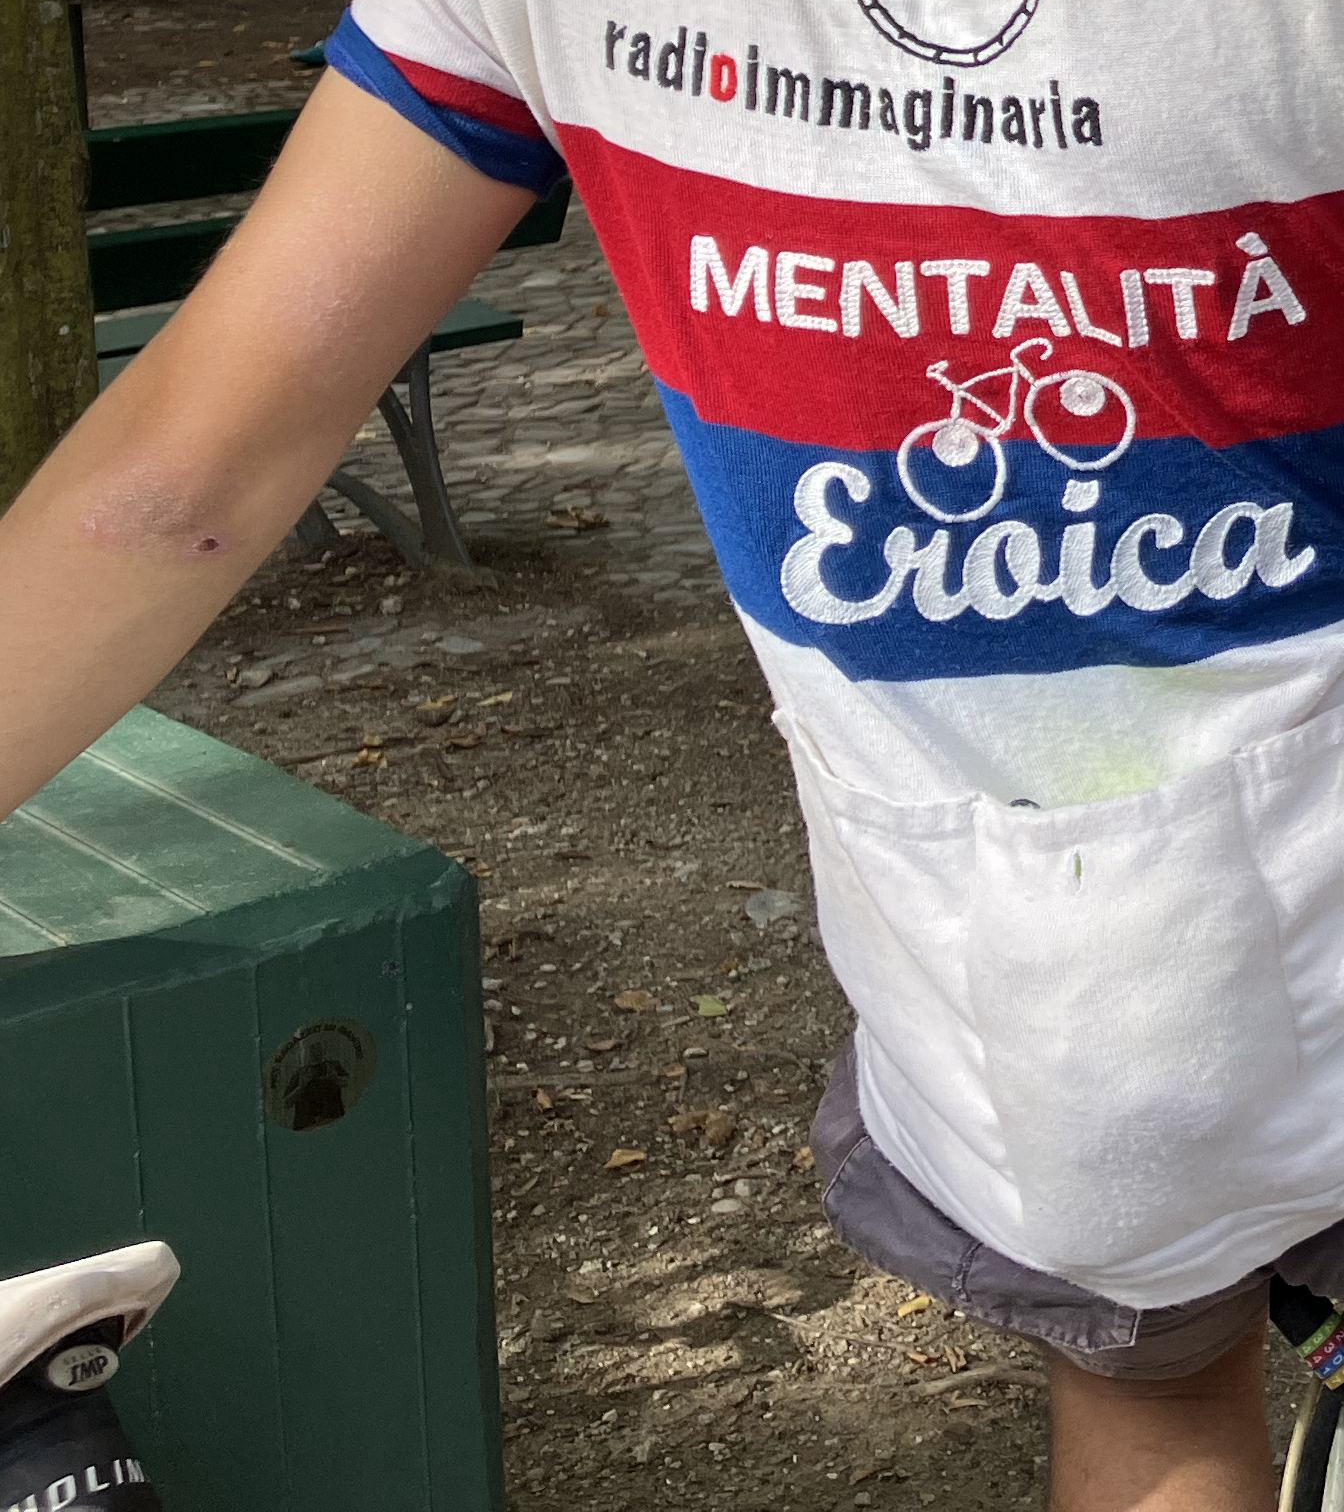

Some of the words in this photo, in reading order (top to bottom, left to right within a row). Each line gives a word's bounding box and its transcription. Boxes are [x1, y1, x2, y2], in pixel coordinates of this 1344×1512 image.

[602, 18, 1106, 153] radioimmaginaria
[686, 231, 1308, 349] MENTALITÀ
[779, 460, 1317, 627] Eroica
